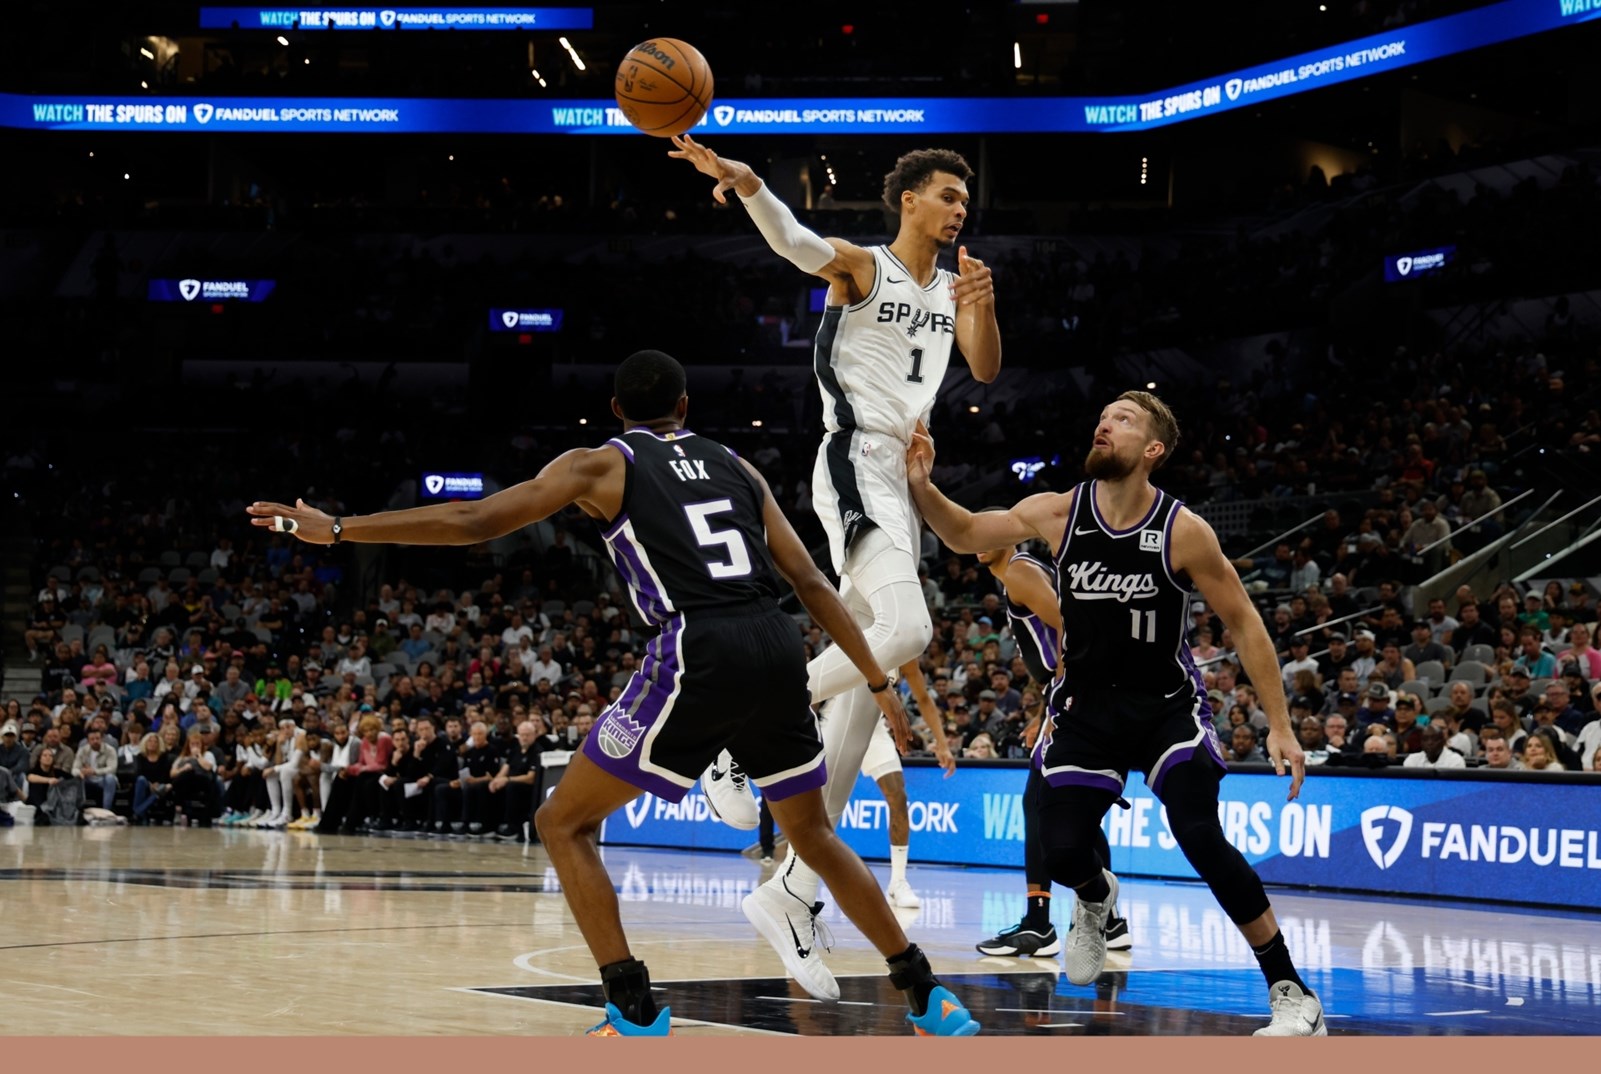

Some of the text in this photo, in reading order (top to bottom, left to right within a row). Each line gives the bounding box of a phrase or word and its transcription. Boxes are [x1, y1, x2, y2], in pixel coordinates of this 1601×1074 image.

[260, 11, 298, 26] WATCH
[299, 12, 321, 26] THE
[359, 12, 376, 26] ON
[397, 13, 444, 24] FANDUEL
[445, 13, 485, 24] SPORTS
[486, 13, 535, 24] NETWORK
[1084, 40, 1406, 124] WATCH THE SPURS ON FANDUEL SPORTS NETWORK
[33, 104, 399, 124] WATCH THE SPURS ON FANDUEL SPORTS NETWORK
[552, 108, 603, 126] WATCH
[736, 109, 801, 124] FANDUEL
[802, 110, 855, 123] SPORTS
[856, 109, 925, 123] NETWORK
[203, 281, 249, 292] FANDUEL
[877, 302, 955, 339] SPURS
[906, 348, 925, 385] 1
[669, 459, 710, 482] FOX
[683, 498, 752, 580] 5
[1067, 561, 1159, 603] Kings
[1129, 608, 1156, 643] 11
[603, 719, 636, 750] KINGS
[654, 794, 723, 823] FAND
[1158, 800, 1273, 856] SRS
[1279, 802, 1333, 859] ON
[1421, 822, 1601, 869] FANDUEL
